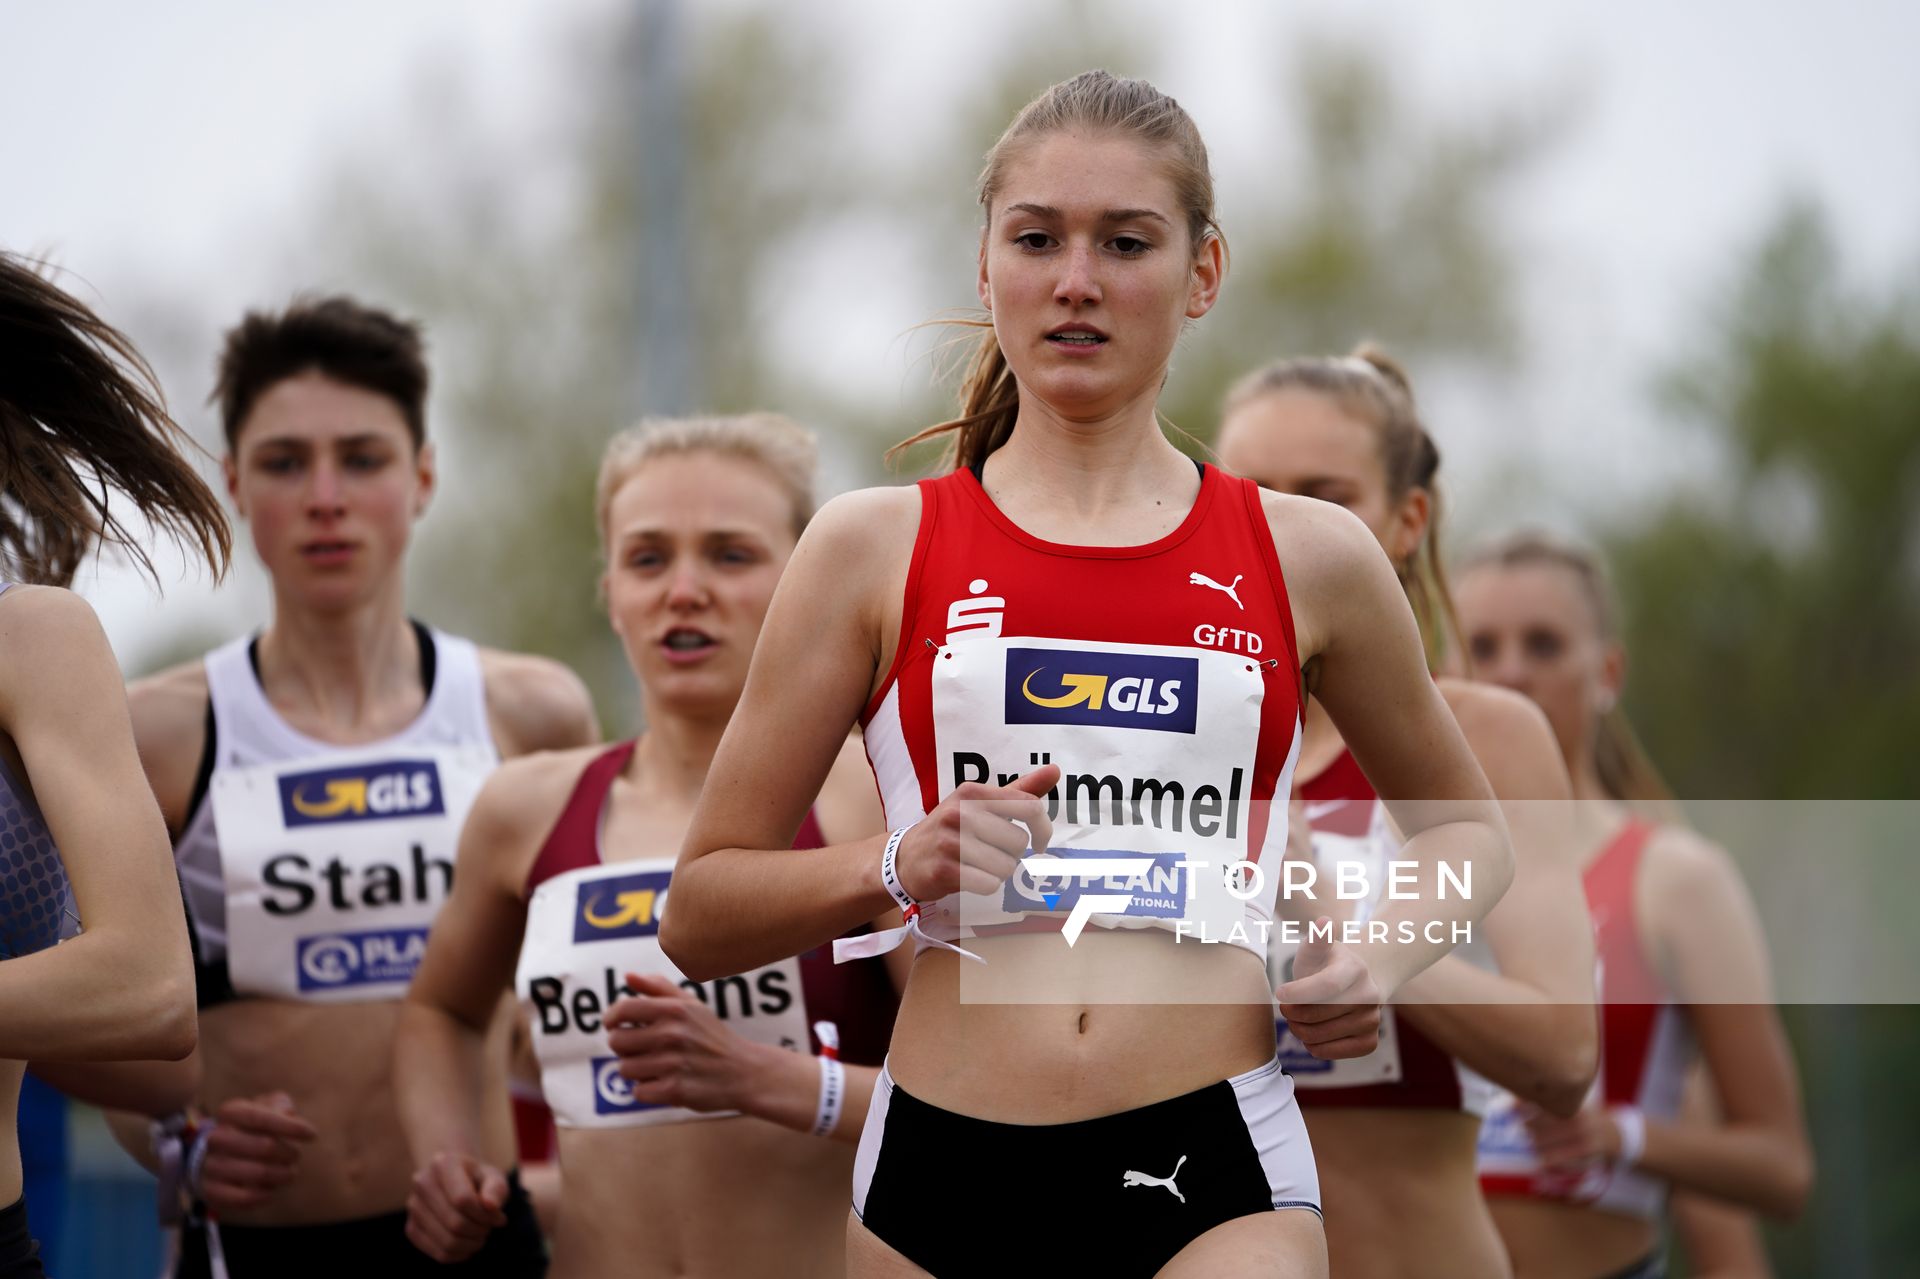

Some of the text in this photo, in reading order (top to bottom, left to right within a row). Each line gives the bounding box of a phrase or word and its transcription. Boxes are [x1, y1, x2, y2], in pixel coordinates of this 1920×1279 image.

[1193, 624, 1263, 654] GfTD
[1108, 677, 1182, 715] GLS
[367, 771, 433, 814] GLS
[530, 966, 793, 1035] Behns
